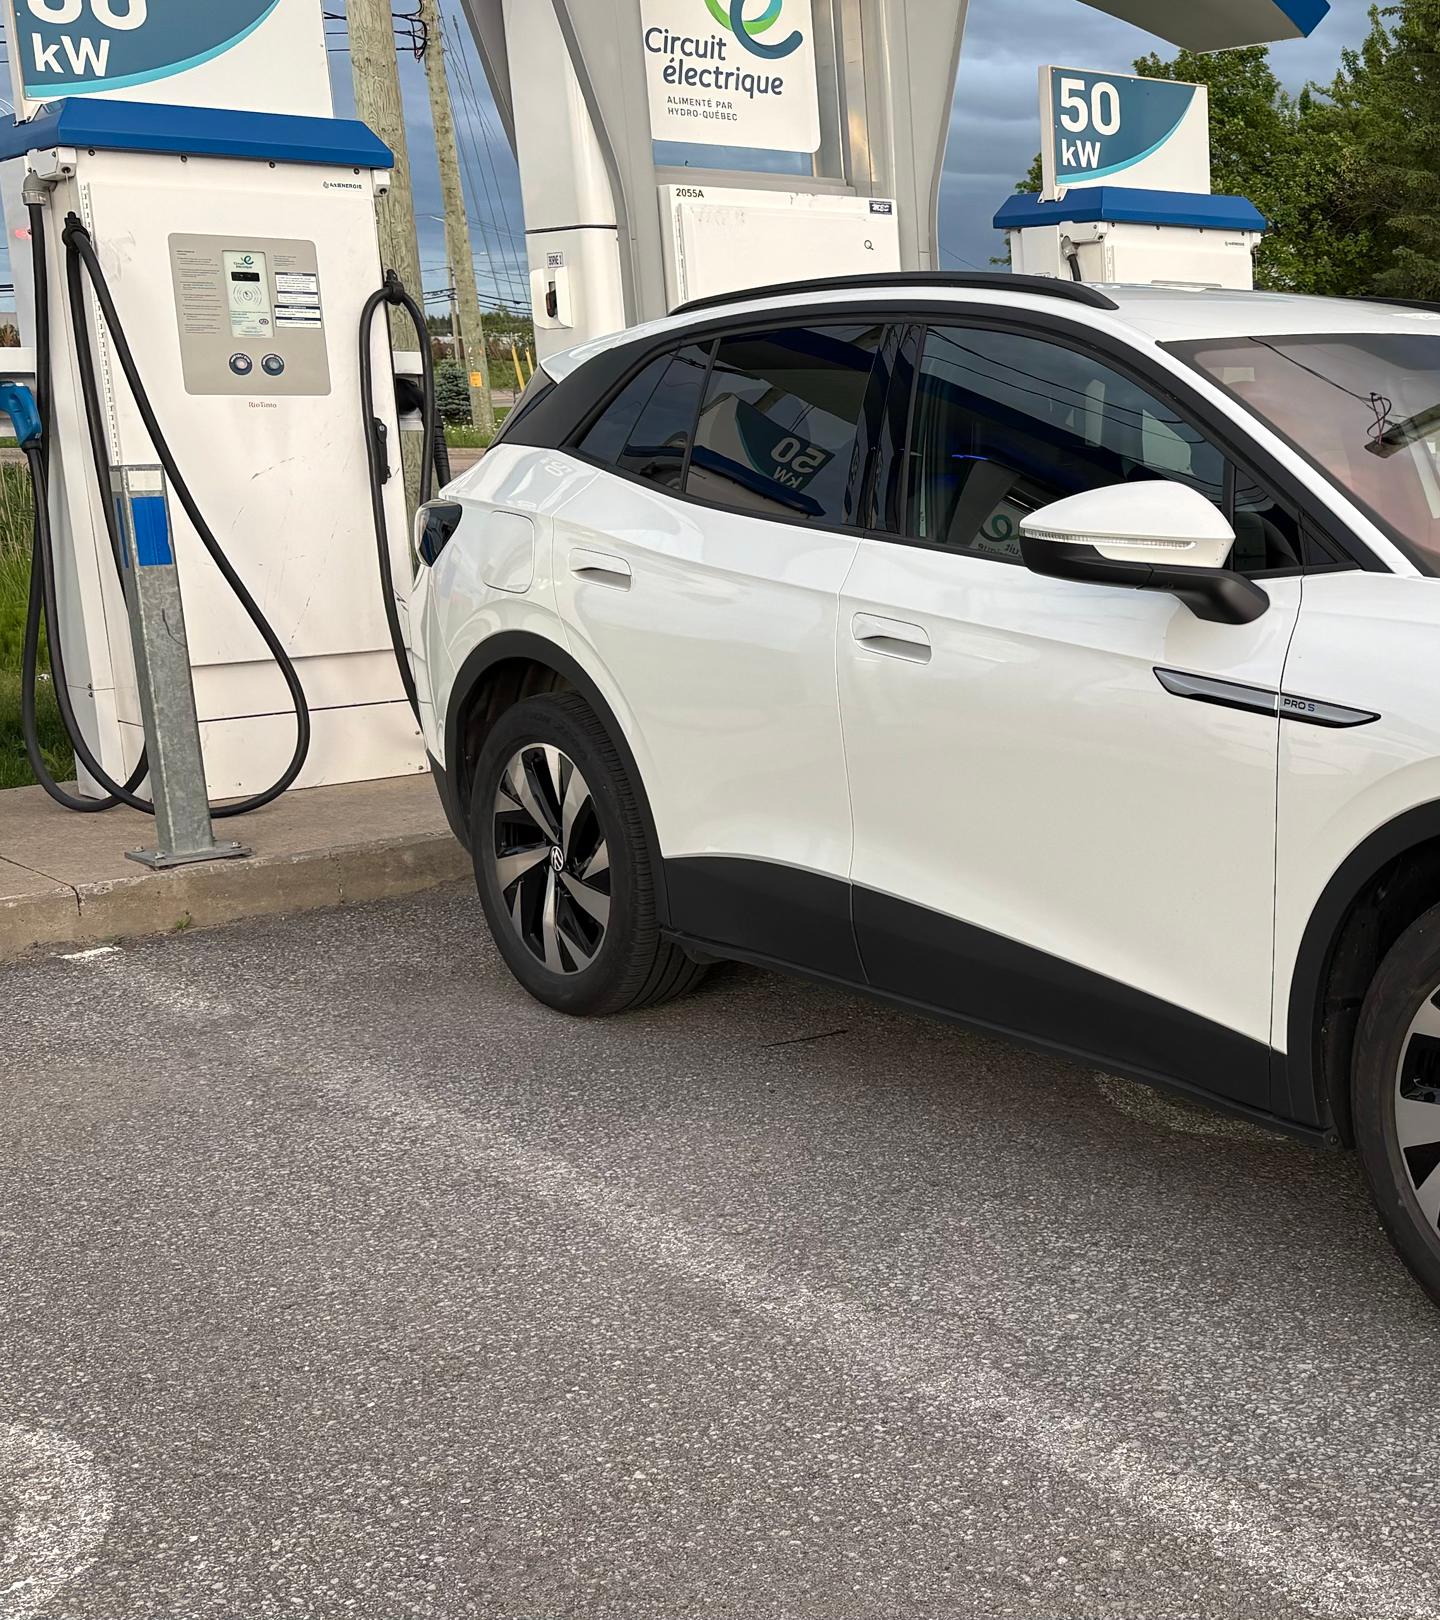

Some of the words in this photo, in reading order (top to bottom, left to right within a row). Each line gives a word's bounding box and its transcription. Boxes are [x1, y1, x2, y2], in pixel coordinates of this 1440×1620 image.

[31, 32, 110, 77] kW
[645, 27, 726, 61] Circuit
[663, 57, 783, 99] électrique
[667, 96, 712, 108] ALIMENTÉ
[716, 101, 733, 110] PAR
[668, 107, 738, 121] HYDRO-QUÉBEC
[1060, 77, 1121, 136] 50
[1061, 139, 1101, 169] kW
[676, 188, 705, 198] 2055A
[1284, 698, 1306, 710] PRO
[1307, 703, 1316, 712] S
